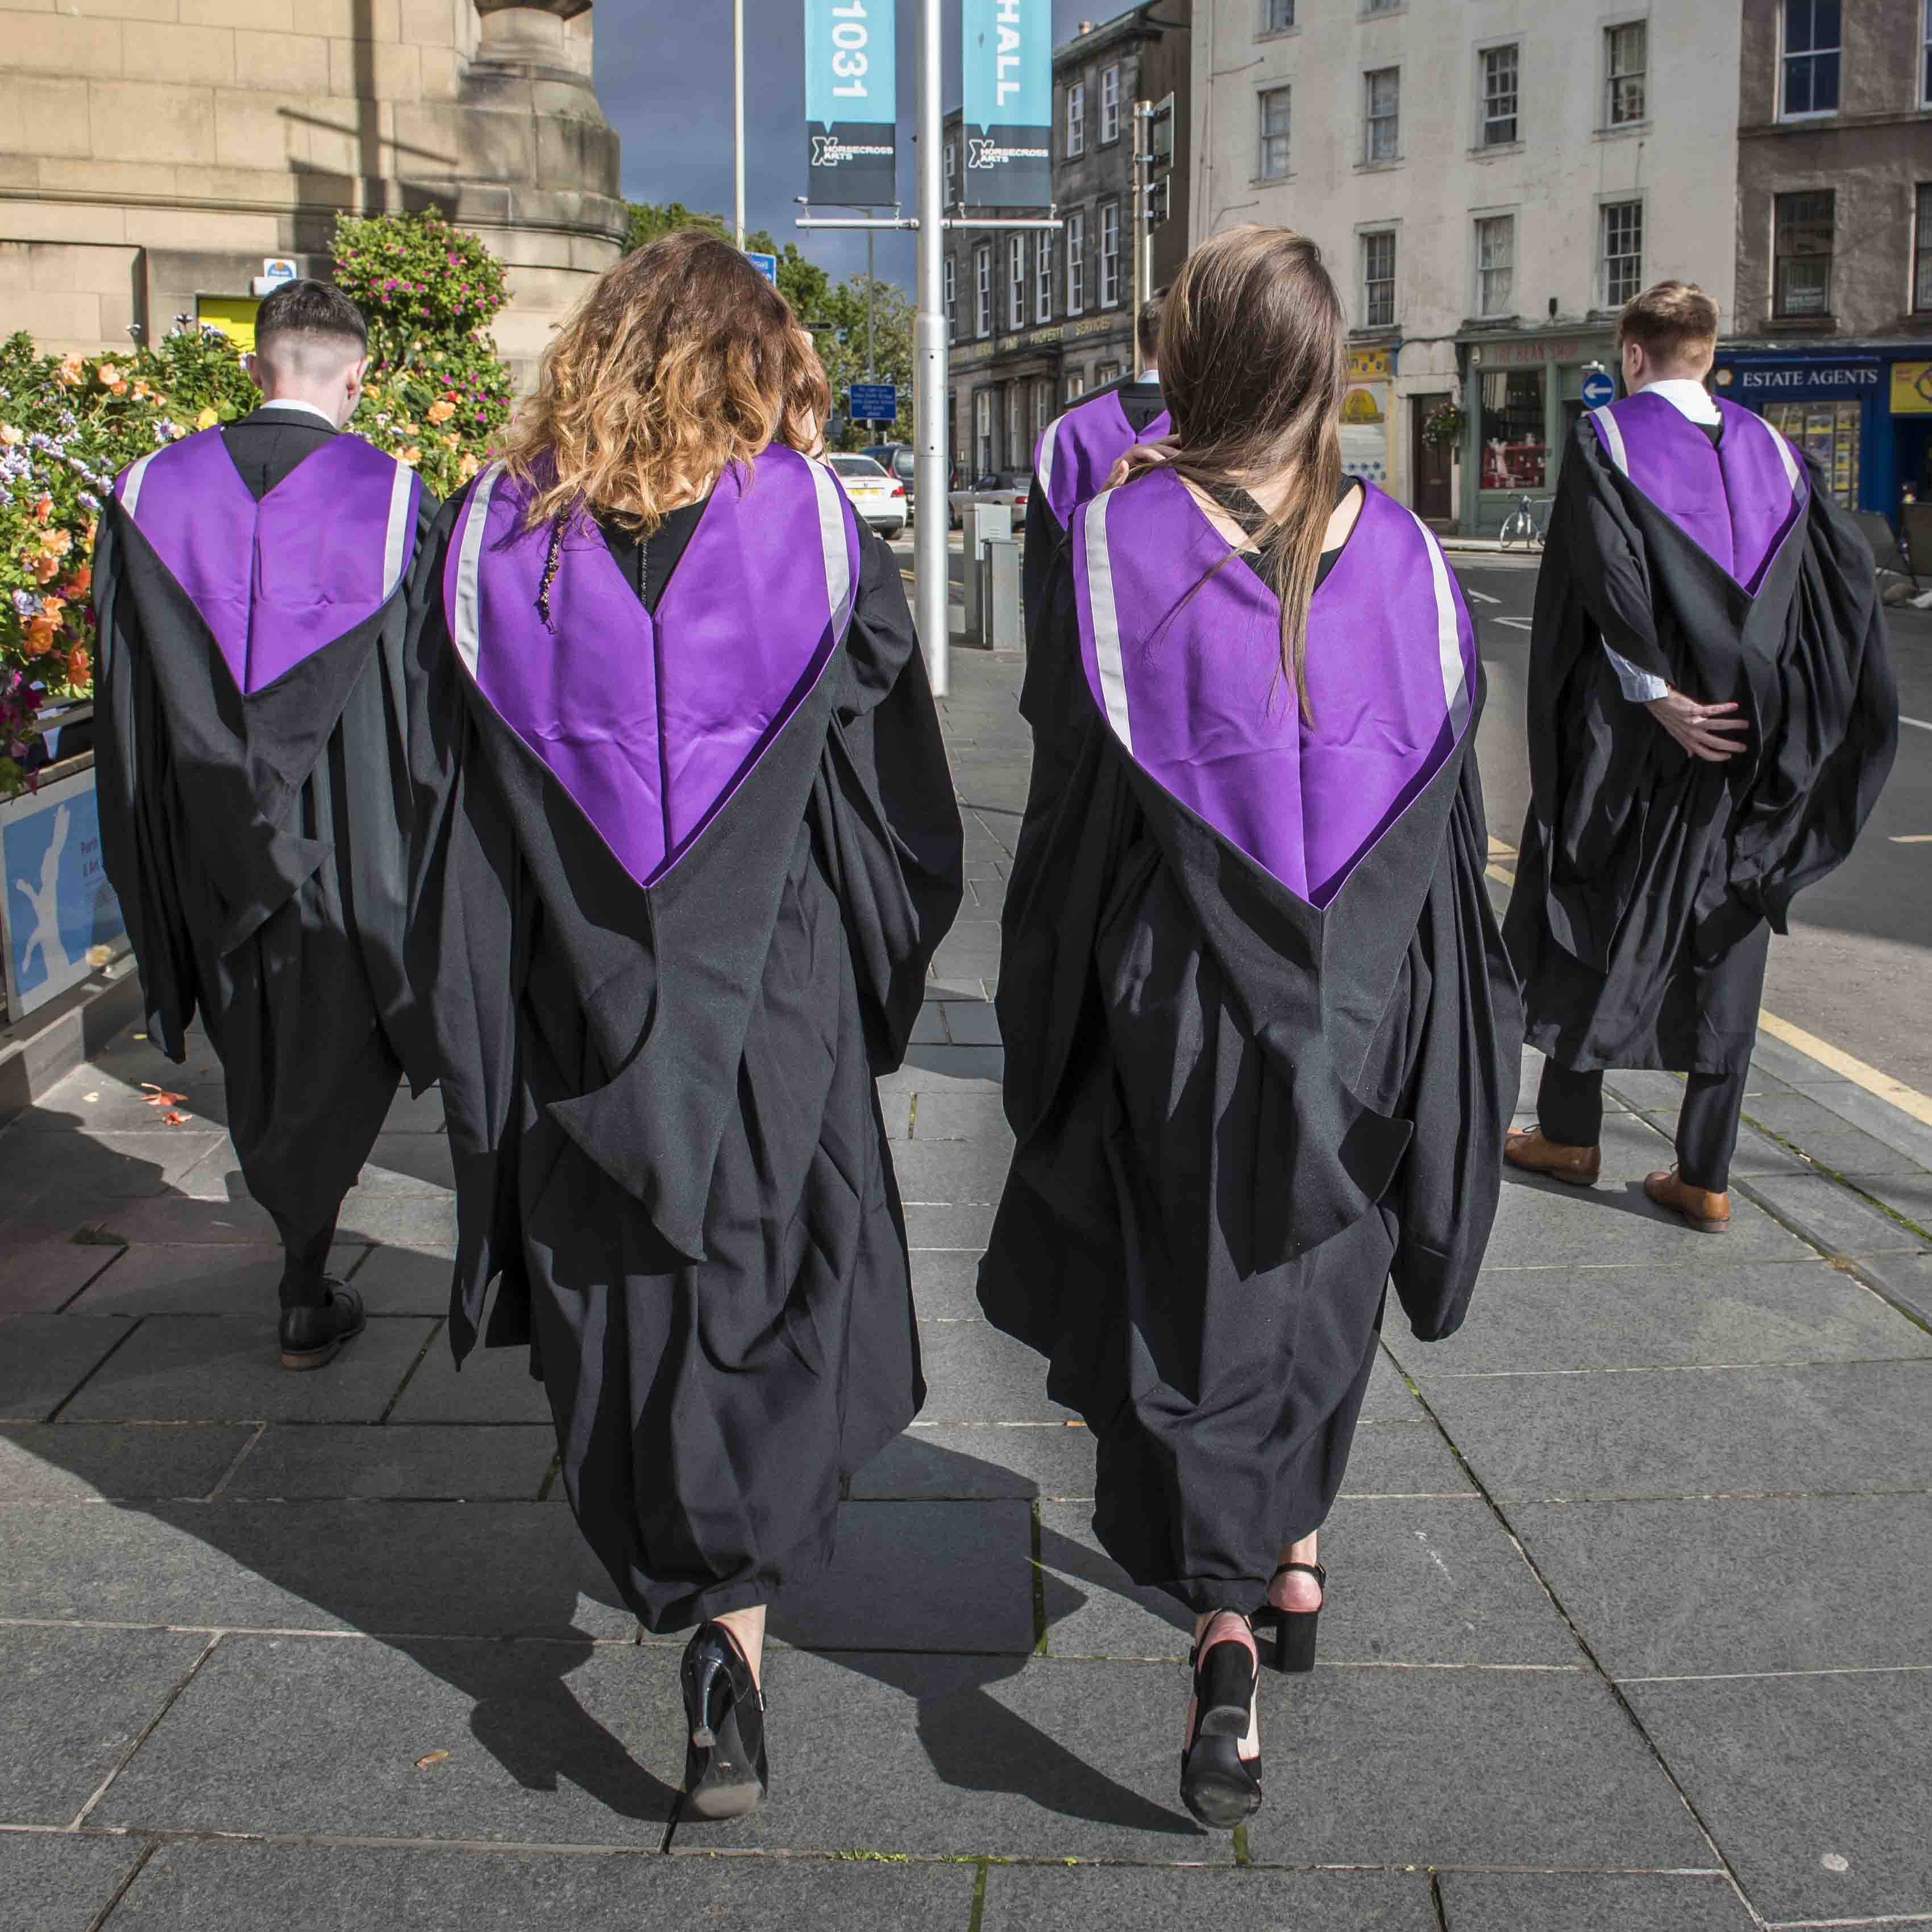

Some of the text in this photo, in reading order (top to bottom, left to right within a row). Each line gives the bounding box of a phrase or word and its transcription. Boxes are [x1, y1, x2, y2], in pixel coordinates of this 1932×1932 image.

[832, 0, 868, 97] 1031
[996, 0, 1021, 106] HALL
[823, 146, 894, 155] HORSECROSS
[980, 148, 1049, 157] HORSECROSS
[980, 155, 1009, 163] ARTS
[1742, 371, 1804, 387] ESTATE
[1807, 368, 1879, 385] AGENTS
